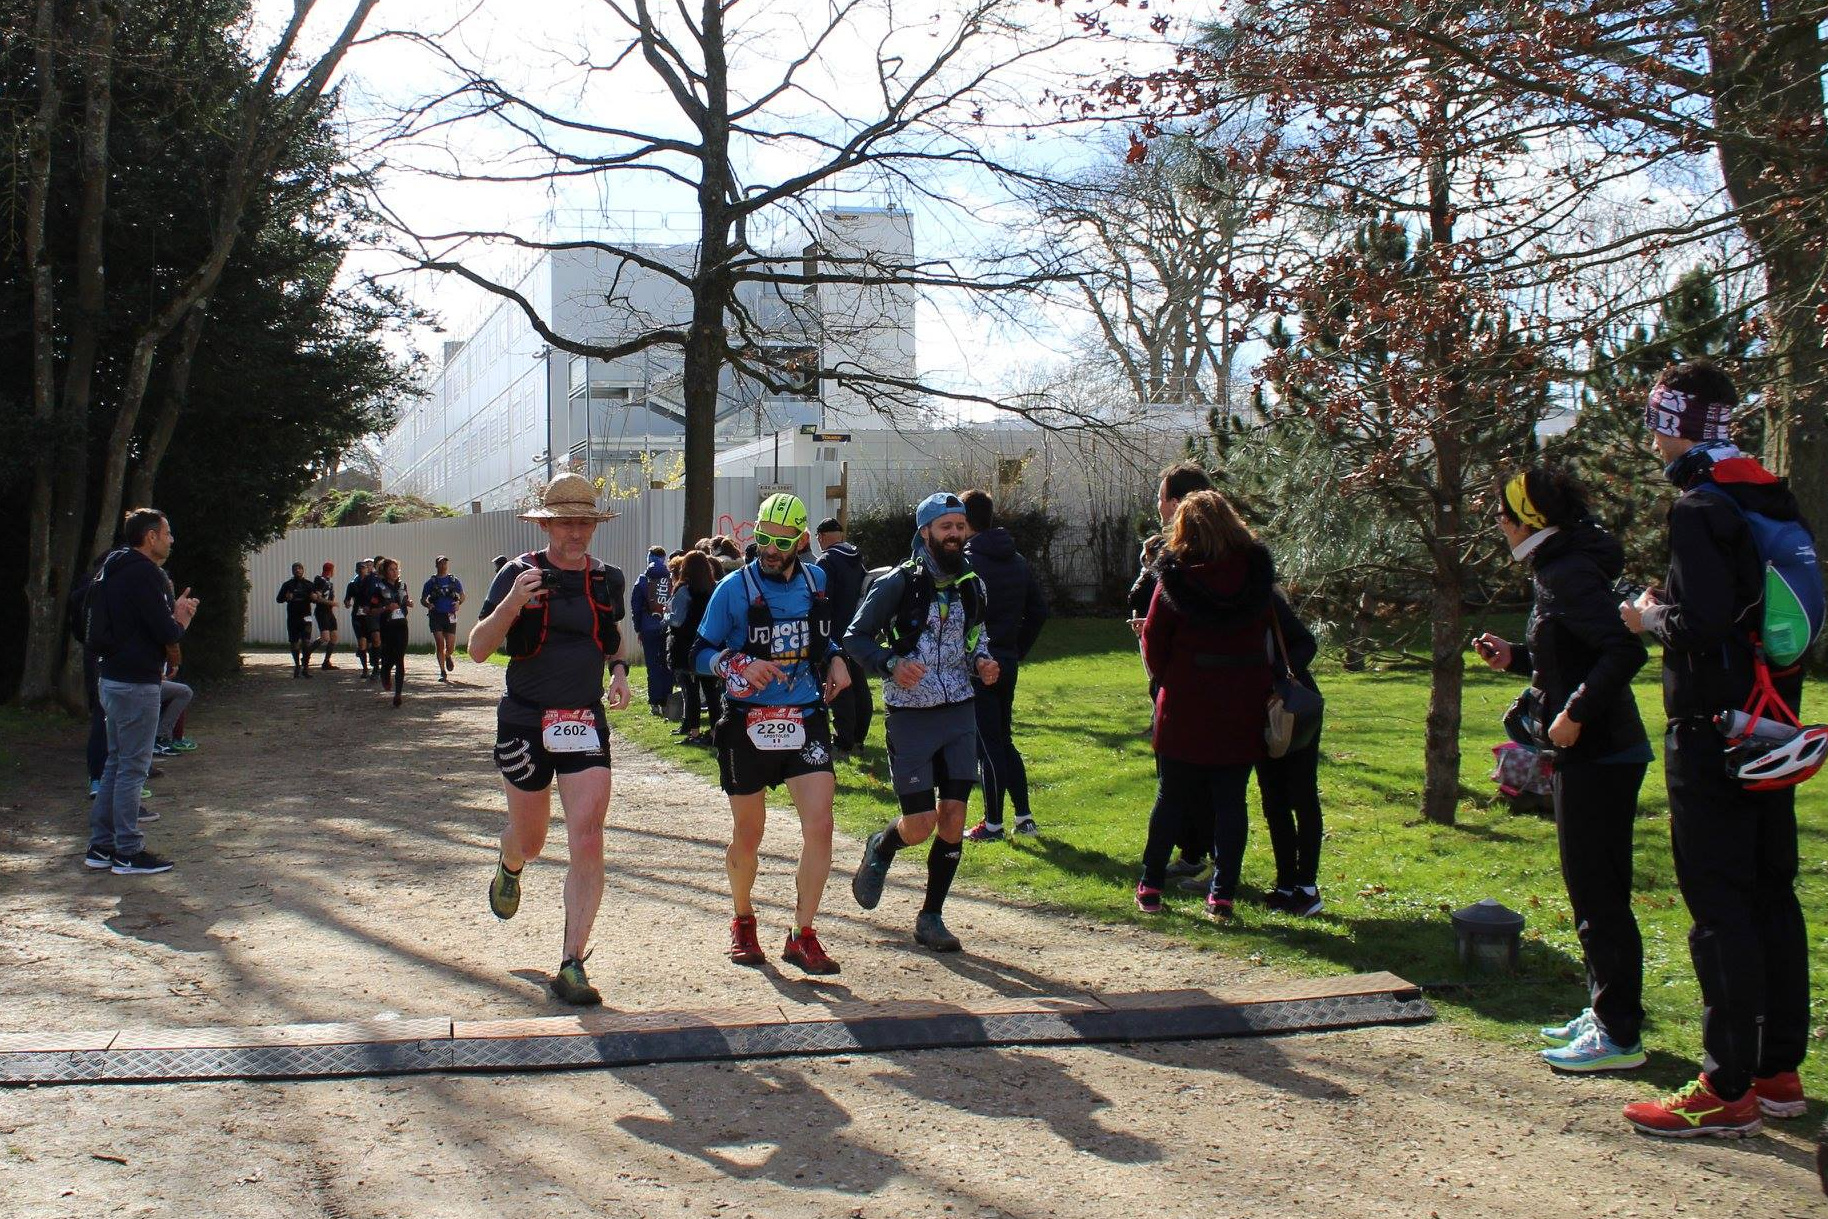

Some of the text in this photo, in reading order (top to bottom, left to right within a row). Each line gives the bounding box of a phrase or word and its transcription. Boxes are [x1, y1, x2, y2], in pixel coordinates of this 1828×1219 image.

[656, 577, 669, 605] sitis
[553, 725, 587, 736] 2602
[757, 723, 796, 734] 2290
